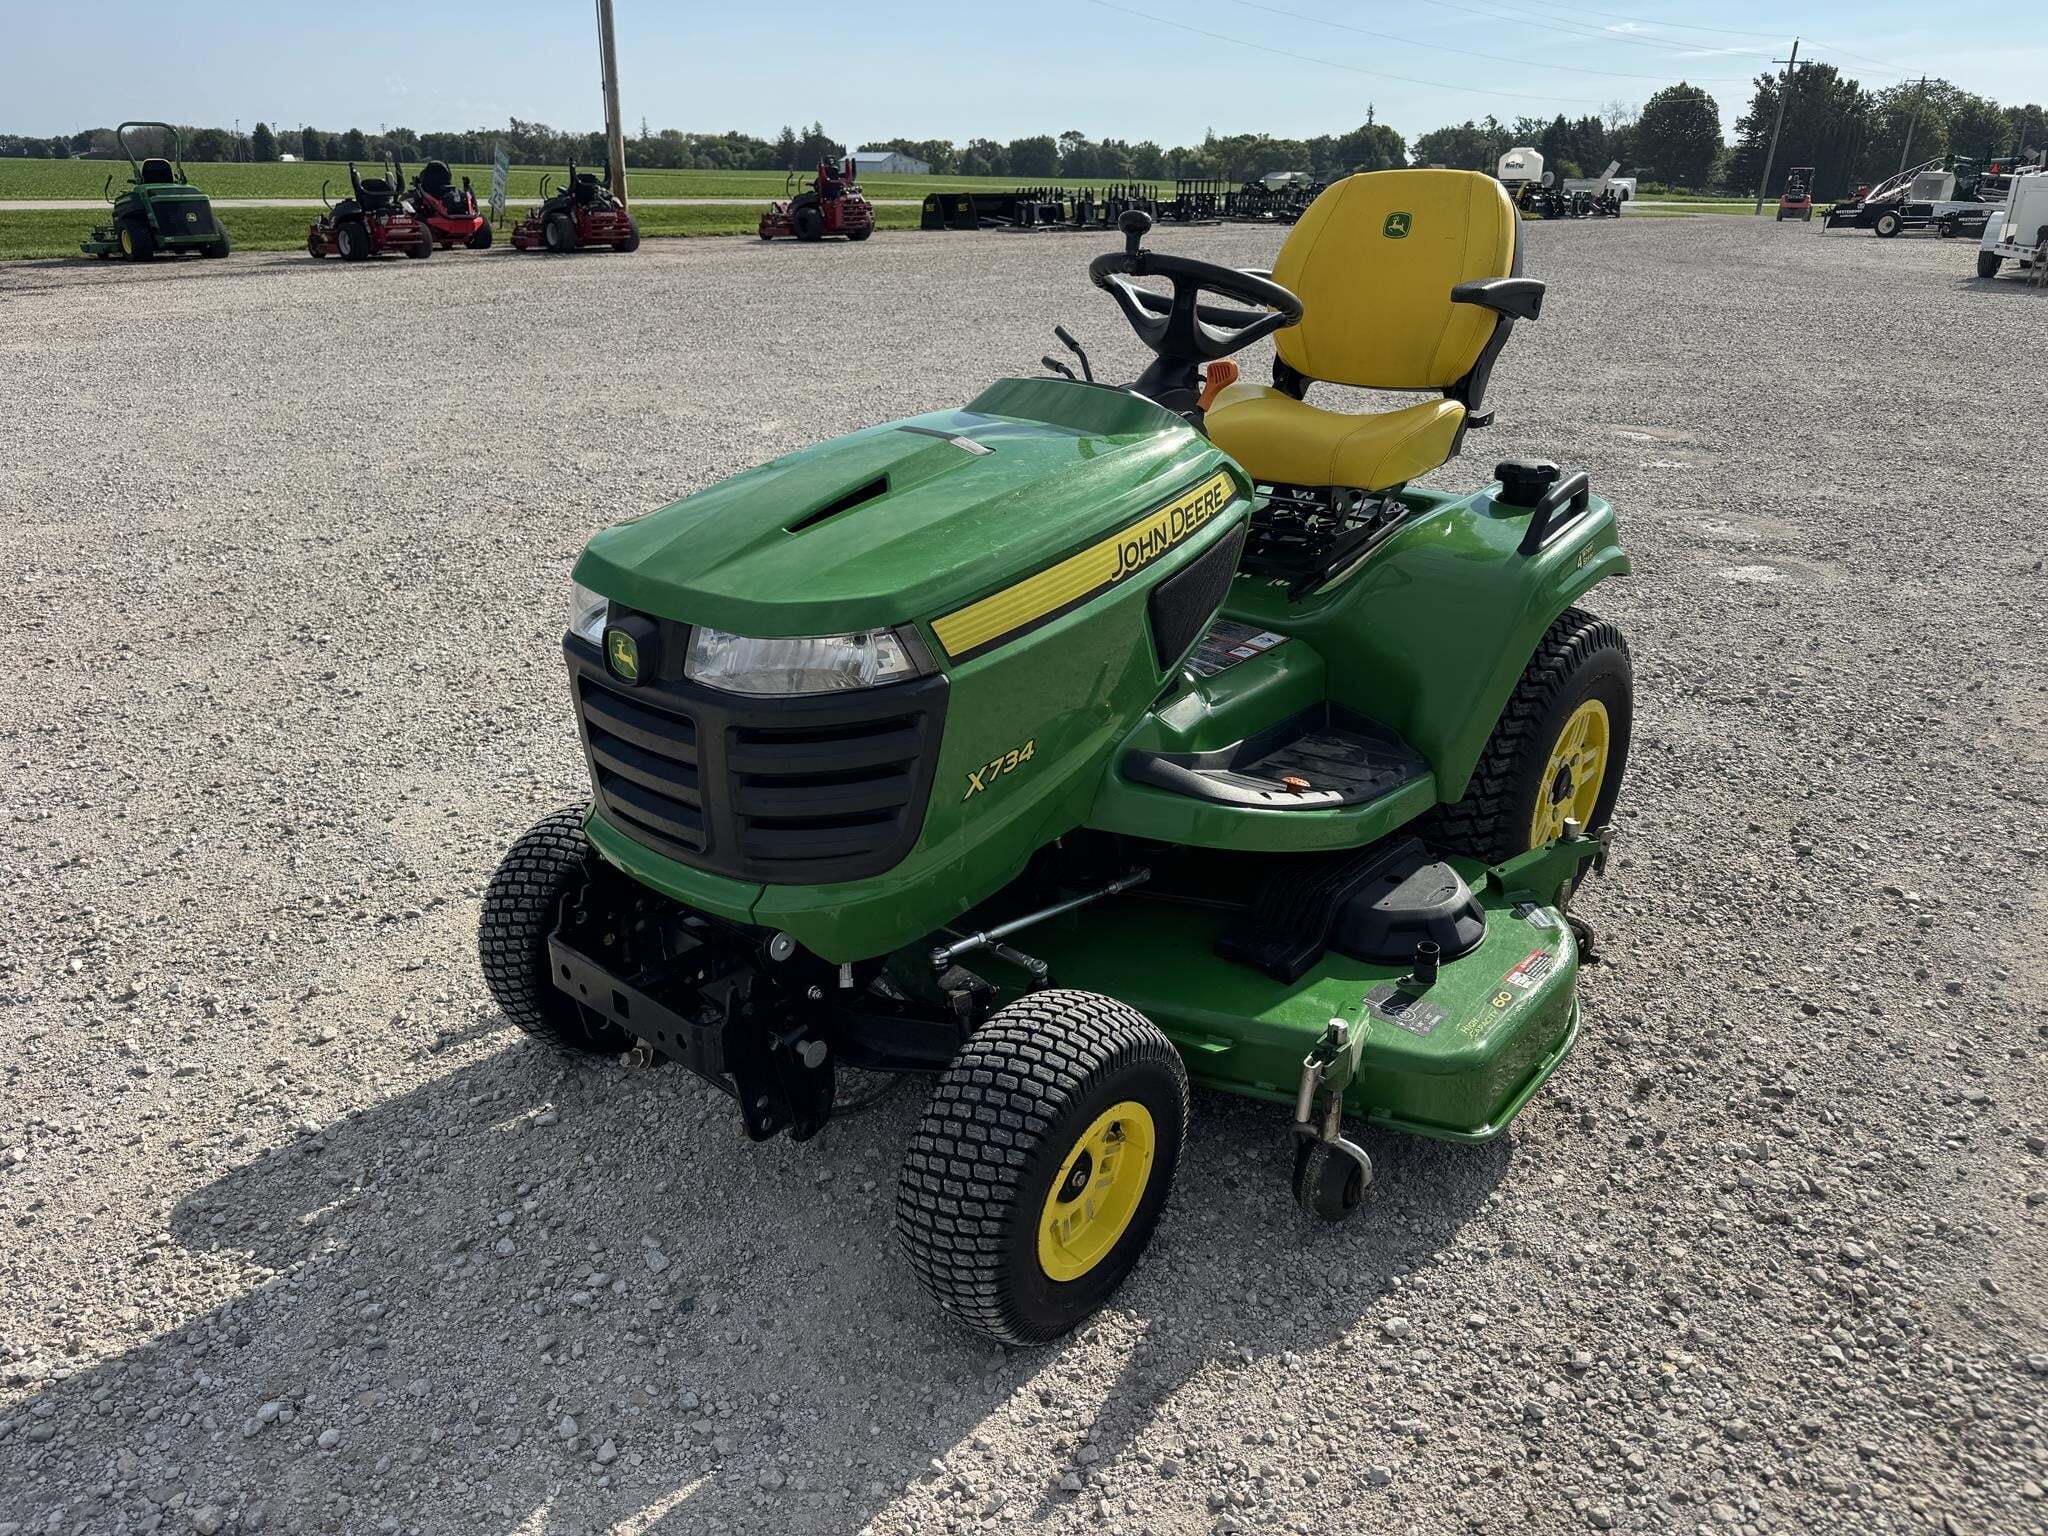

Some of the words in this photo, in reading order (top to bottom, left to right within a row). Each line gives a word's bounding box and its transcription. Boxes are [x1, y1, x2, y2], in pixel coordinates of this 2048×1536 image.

[1111, 521, 1169, 581] JOHN
[1170, 482, 1224, 541] DEERE
[961, 738, 1035, 802] X734
[1492, 990, 1512, 1008] 60
[1460, 1017, 1479, 1034] HIGH
[1468, 1008, 1499, 1039] CAPACITY
